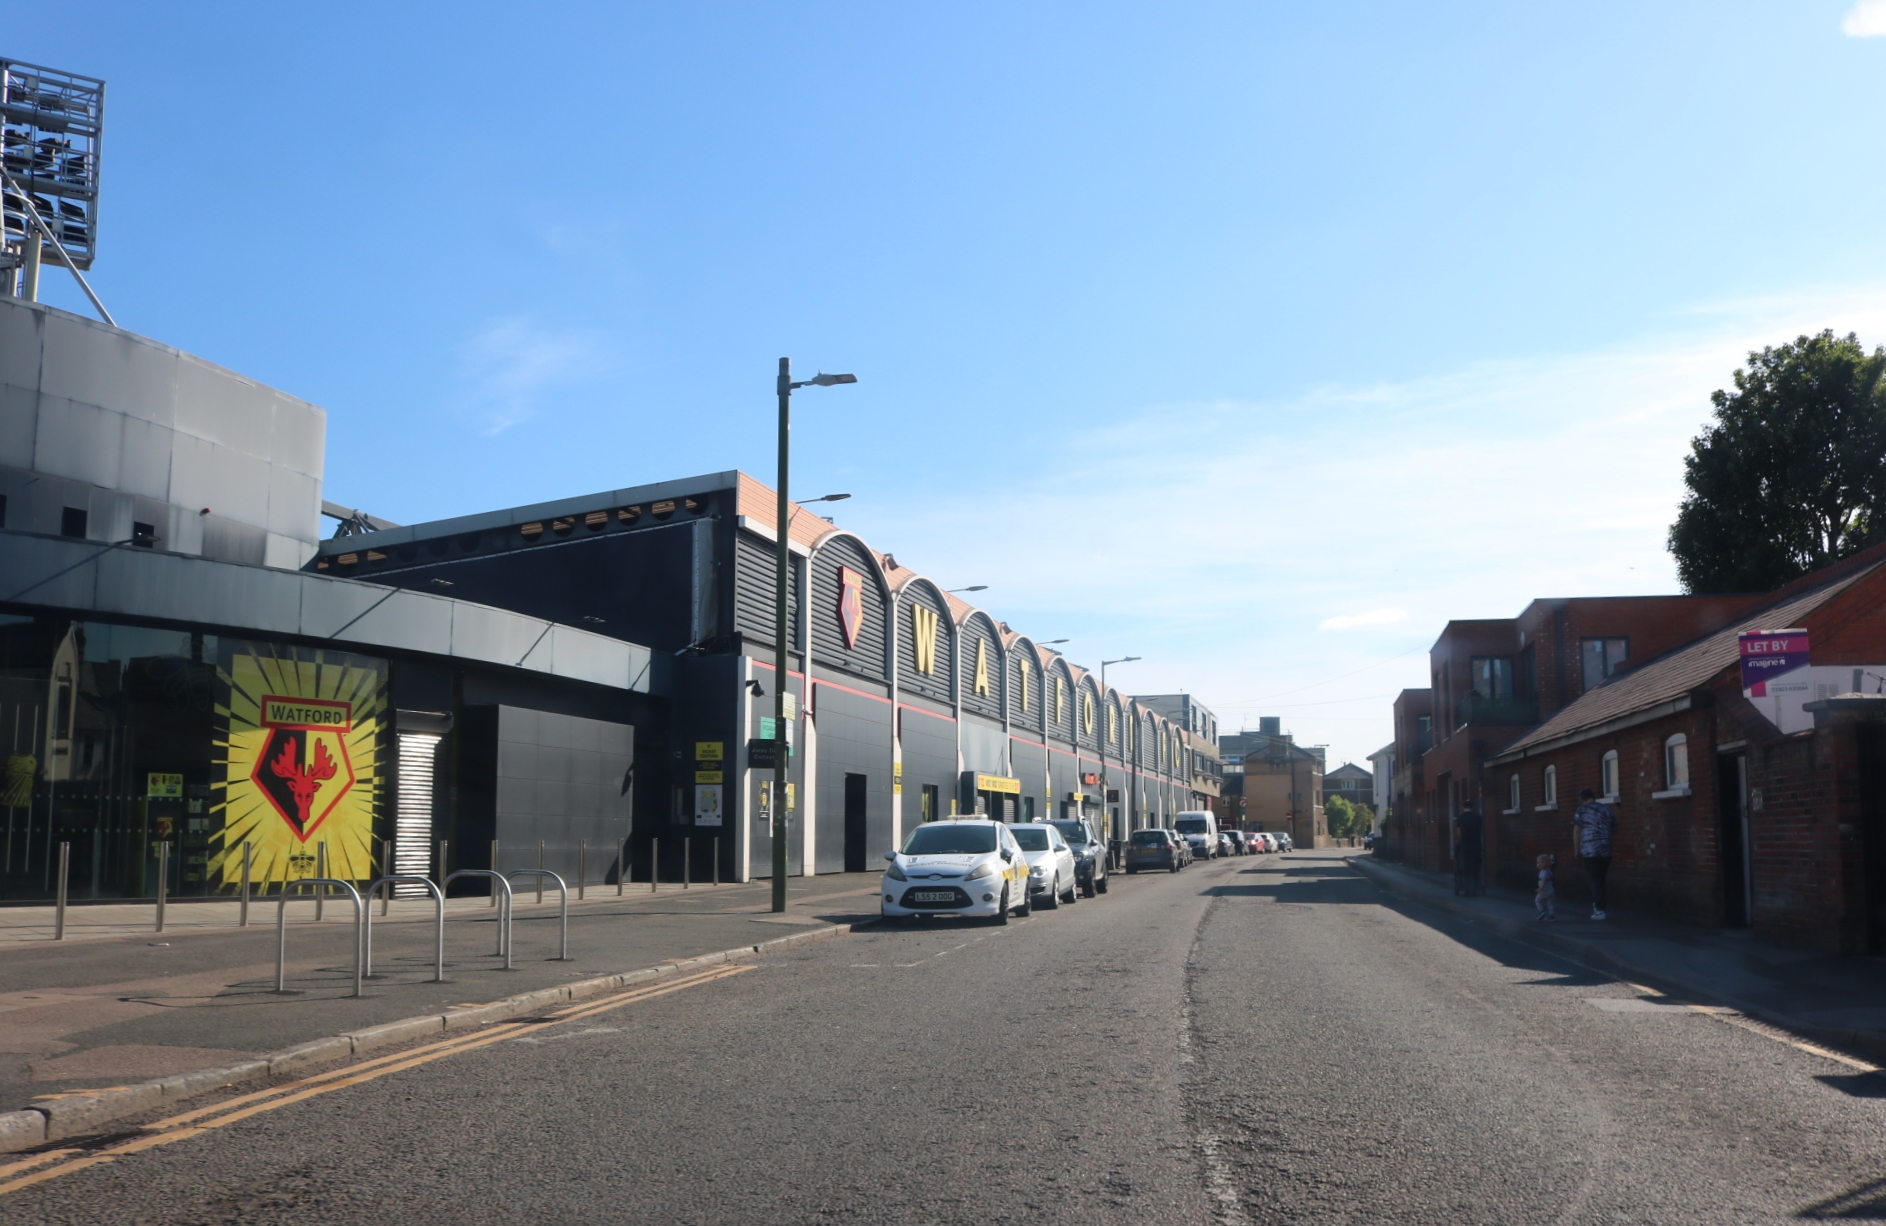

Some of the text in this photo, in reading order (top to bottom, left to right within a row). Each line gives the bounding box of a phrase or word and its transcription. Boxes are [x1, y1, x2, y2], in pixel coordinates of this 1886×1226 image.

[1747, 640, 1788, 652] LET BY
[1748, 659, 1778, 668] imagine
[271, 704, 343, 725] WATFORD
